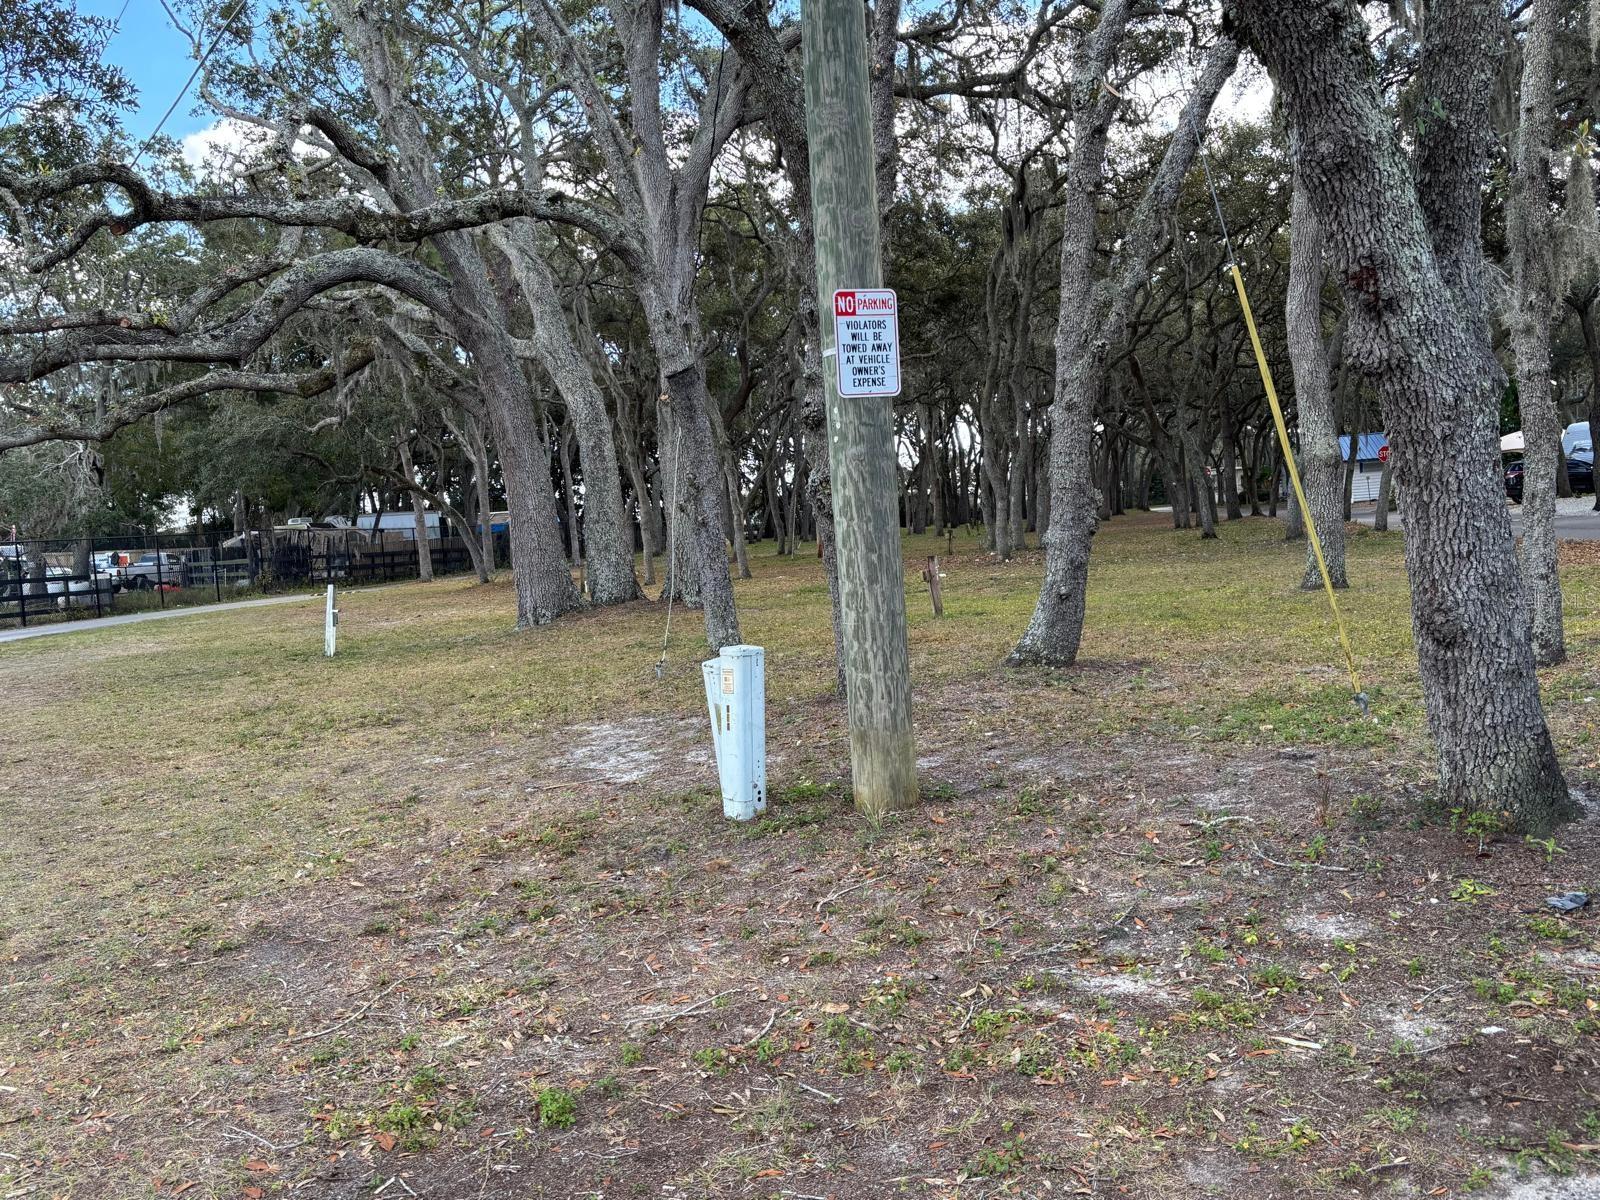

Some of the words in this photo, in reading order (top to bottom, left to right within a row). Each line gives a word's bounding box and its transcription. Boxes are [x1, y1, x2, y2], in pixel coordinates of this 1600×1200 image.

[838, 296, 854, 313] NO
[858, 298, 893, 310] PARKING
[846, 320, 887, 331] VIOLATORS
[851, 332, 869, 342] WILL
[873, 332, 883, 341] BE
[842, 343, 867, 353] TOWED
[871, 343, 893, 352] AWAY
[846, 355, 855, 365] AT
[858, 354, 890, 364] VEHICLE
[852, 365, 886, 376] OWNER'S
[853, 377, 886, 388] EXPENSE
